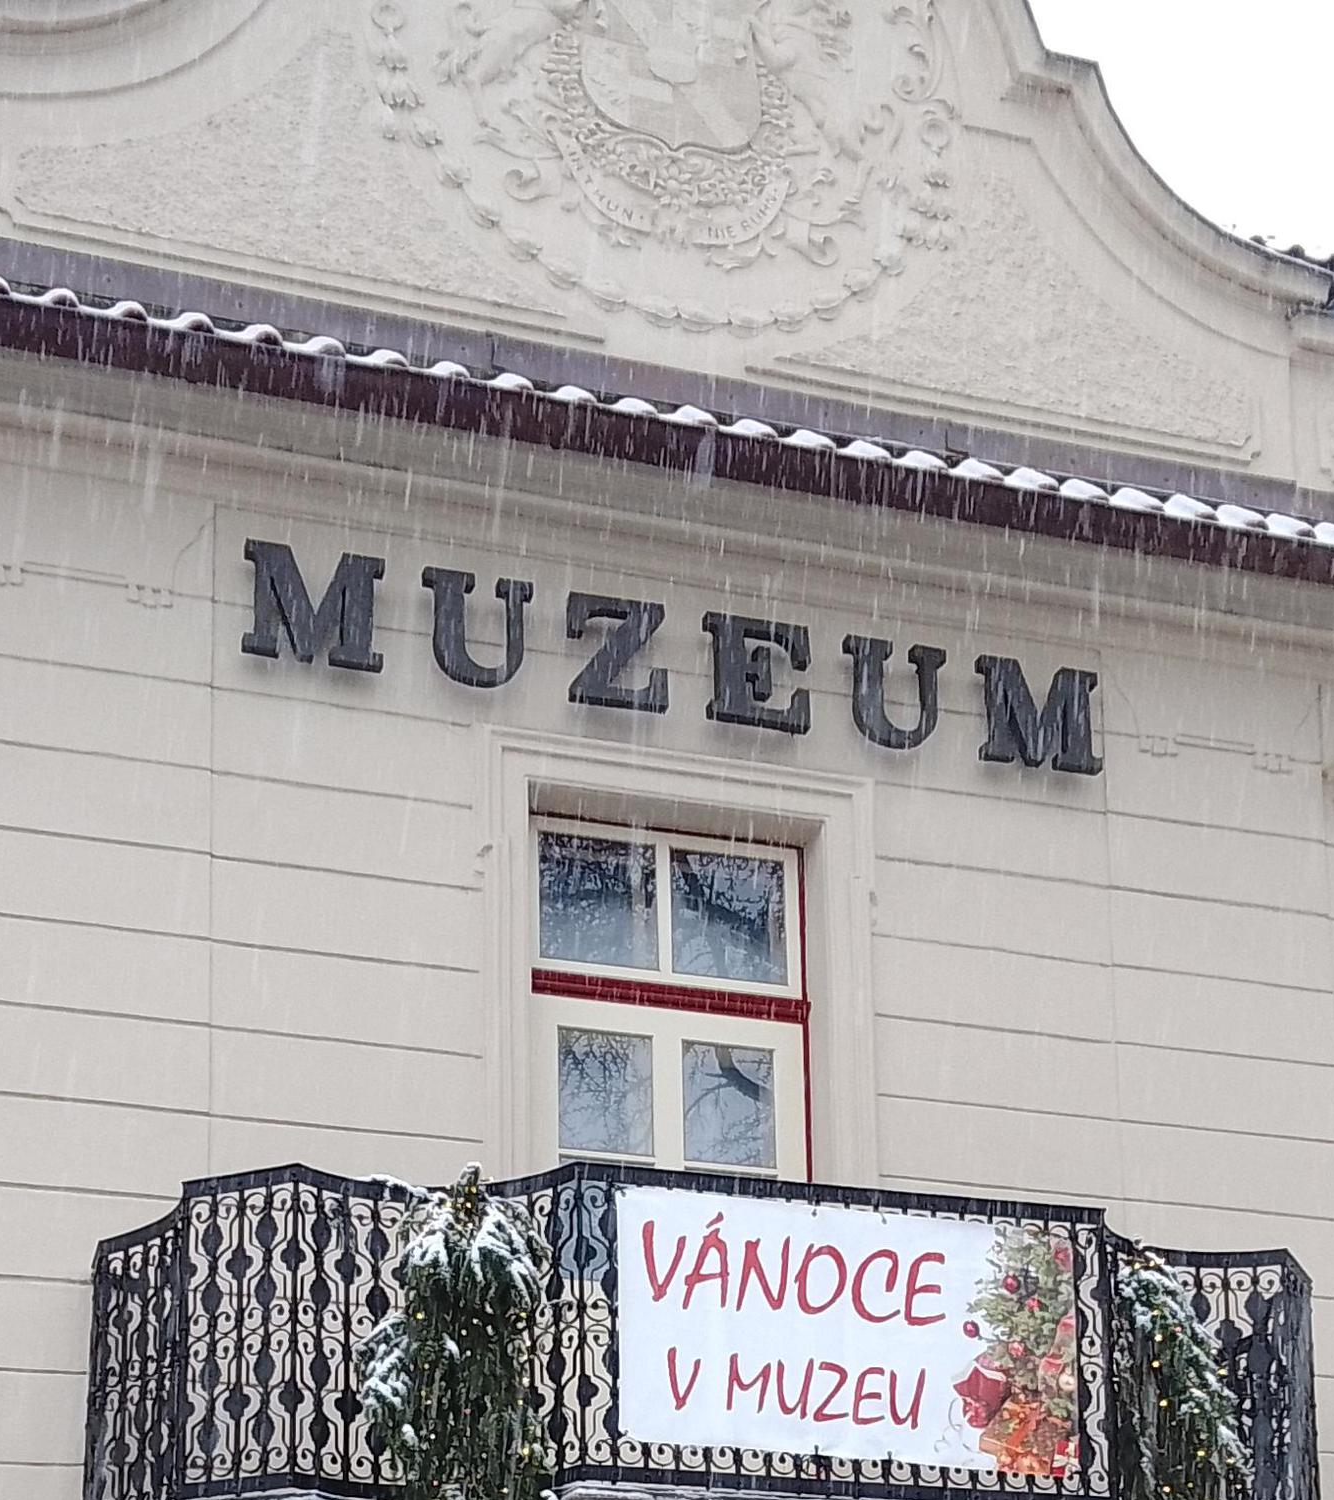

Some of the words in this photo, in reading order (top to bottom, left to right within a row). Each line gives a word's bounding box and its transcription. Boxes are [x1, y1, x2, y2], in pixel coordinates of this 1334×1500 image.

[240, 537, 1104, 777] MUZEUM
[642, 1211, 947, 1327] VÁNOCE
[667, 1346, 701, 1411] V
[726, 1352, 927, 1430] MUZEU
